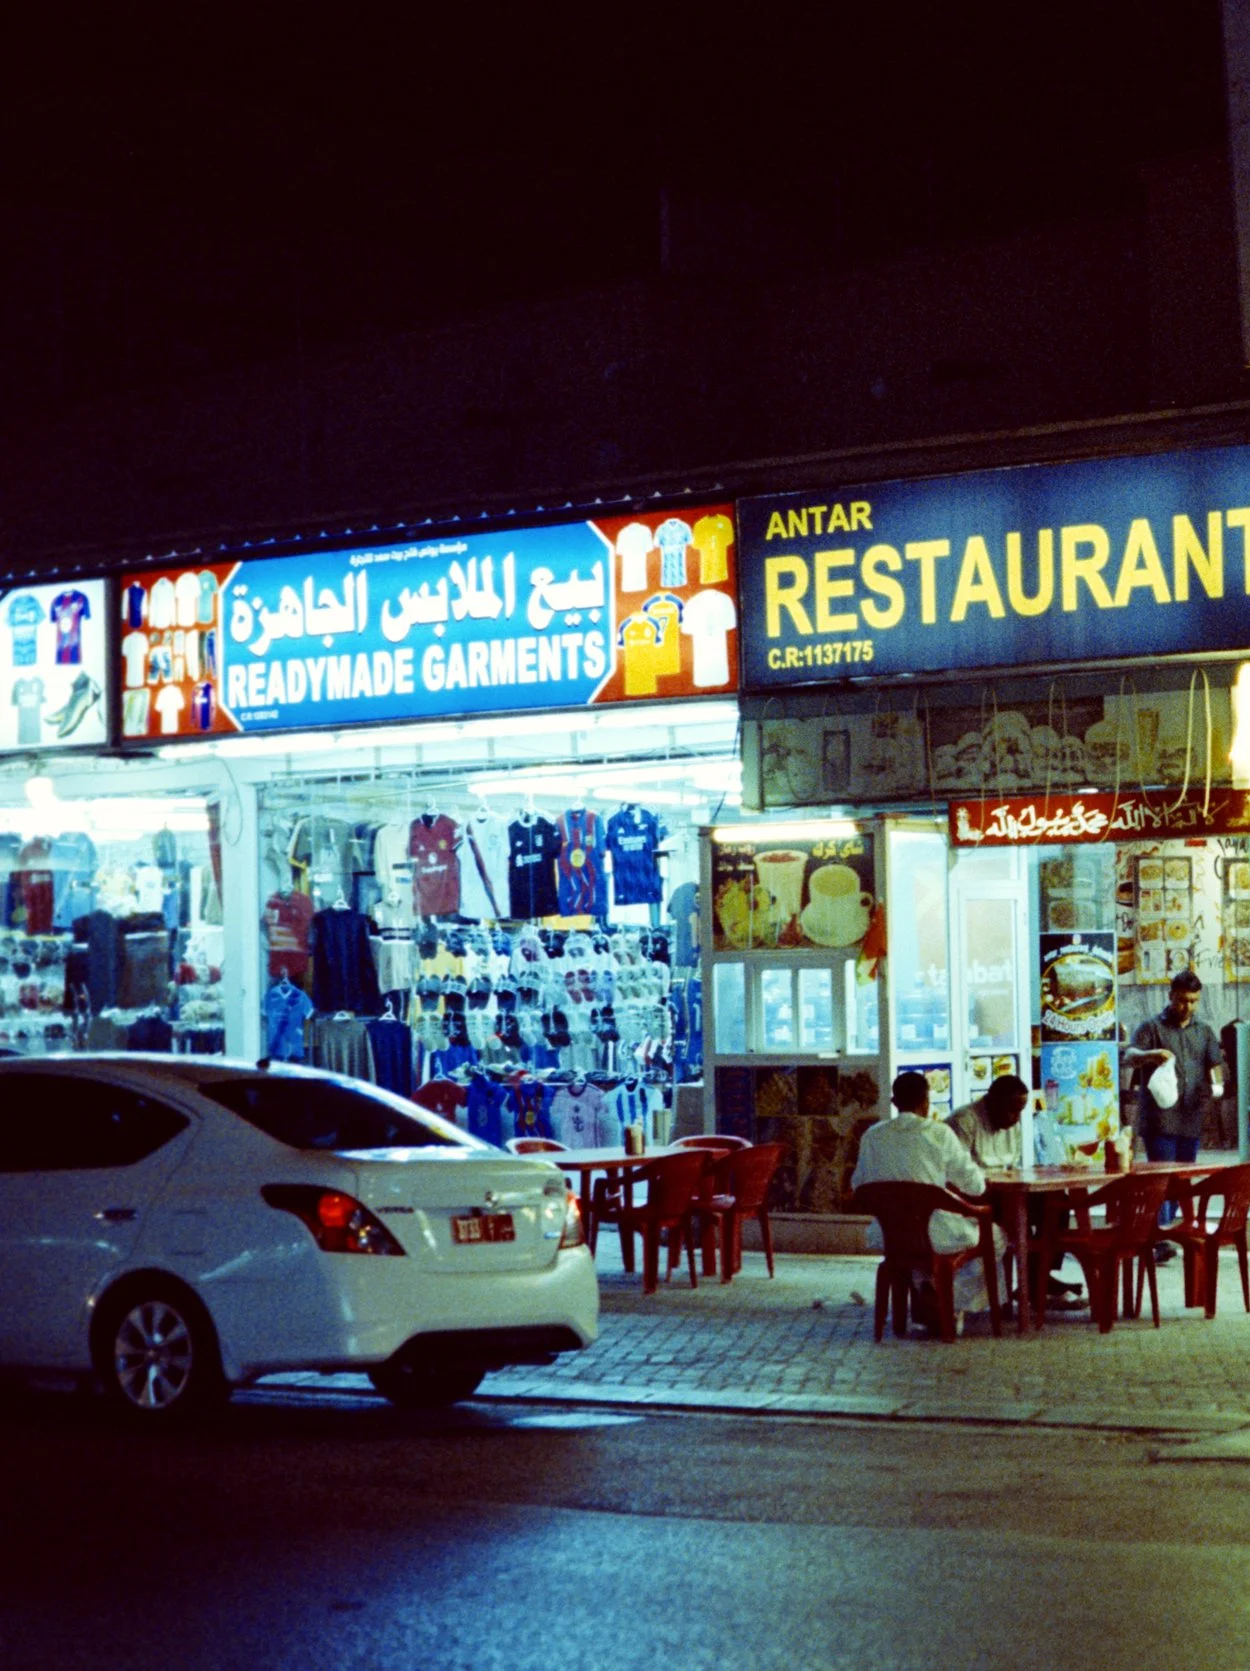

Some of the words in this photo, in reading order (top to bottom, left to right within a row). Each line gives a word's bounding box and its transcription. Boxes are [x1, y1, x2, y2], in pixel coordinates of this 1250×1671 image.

[765, 501, 872, 541] ANTAR
[230, 568, 369, 657] الجاهزة
[381, 551, 516, 643] الملابس
[528, 559, 605, 632] بيع
[228, 647, 415, 709] READYMADE
[421, 630, 606, 692] GARMENTS
[767, 640, 874, 670] C.R:1137175
[1053, 1014, 1088, 1035] Hours
